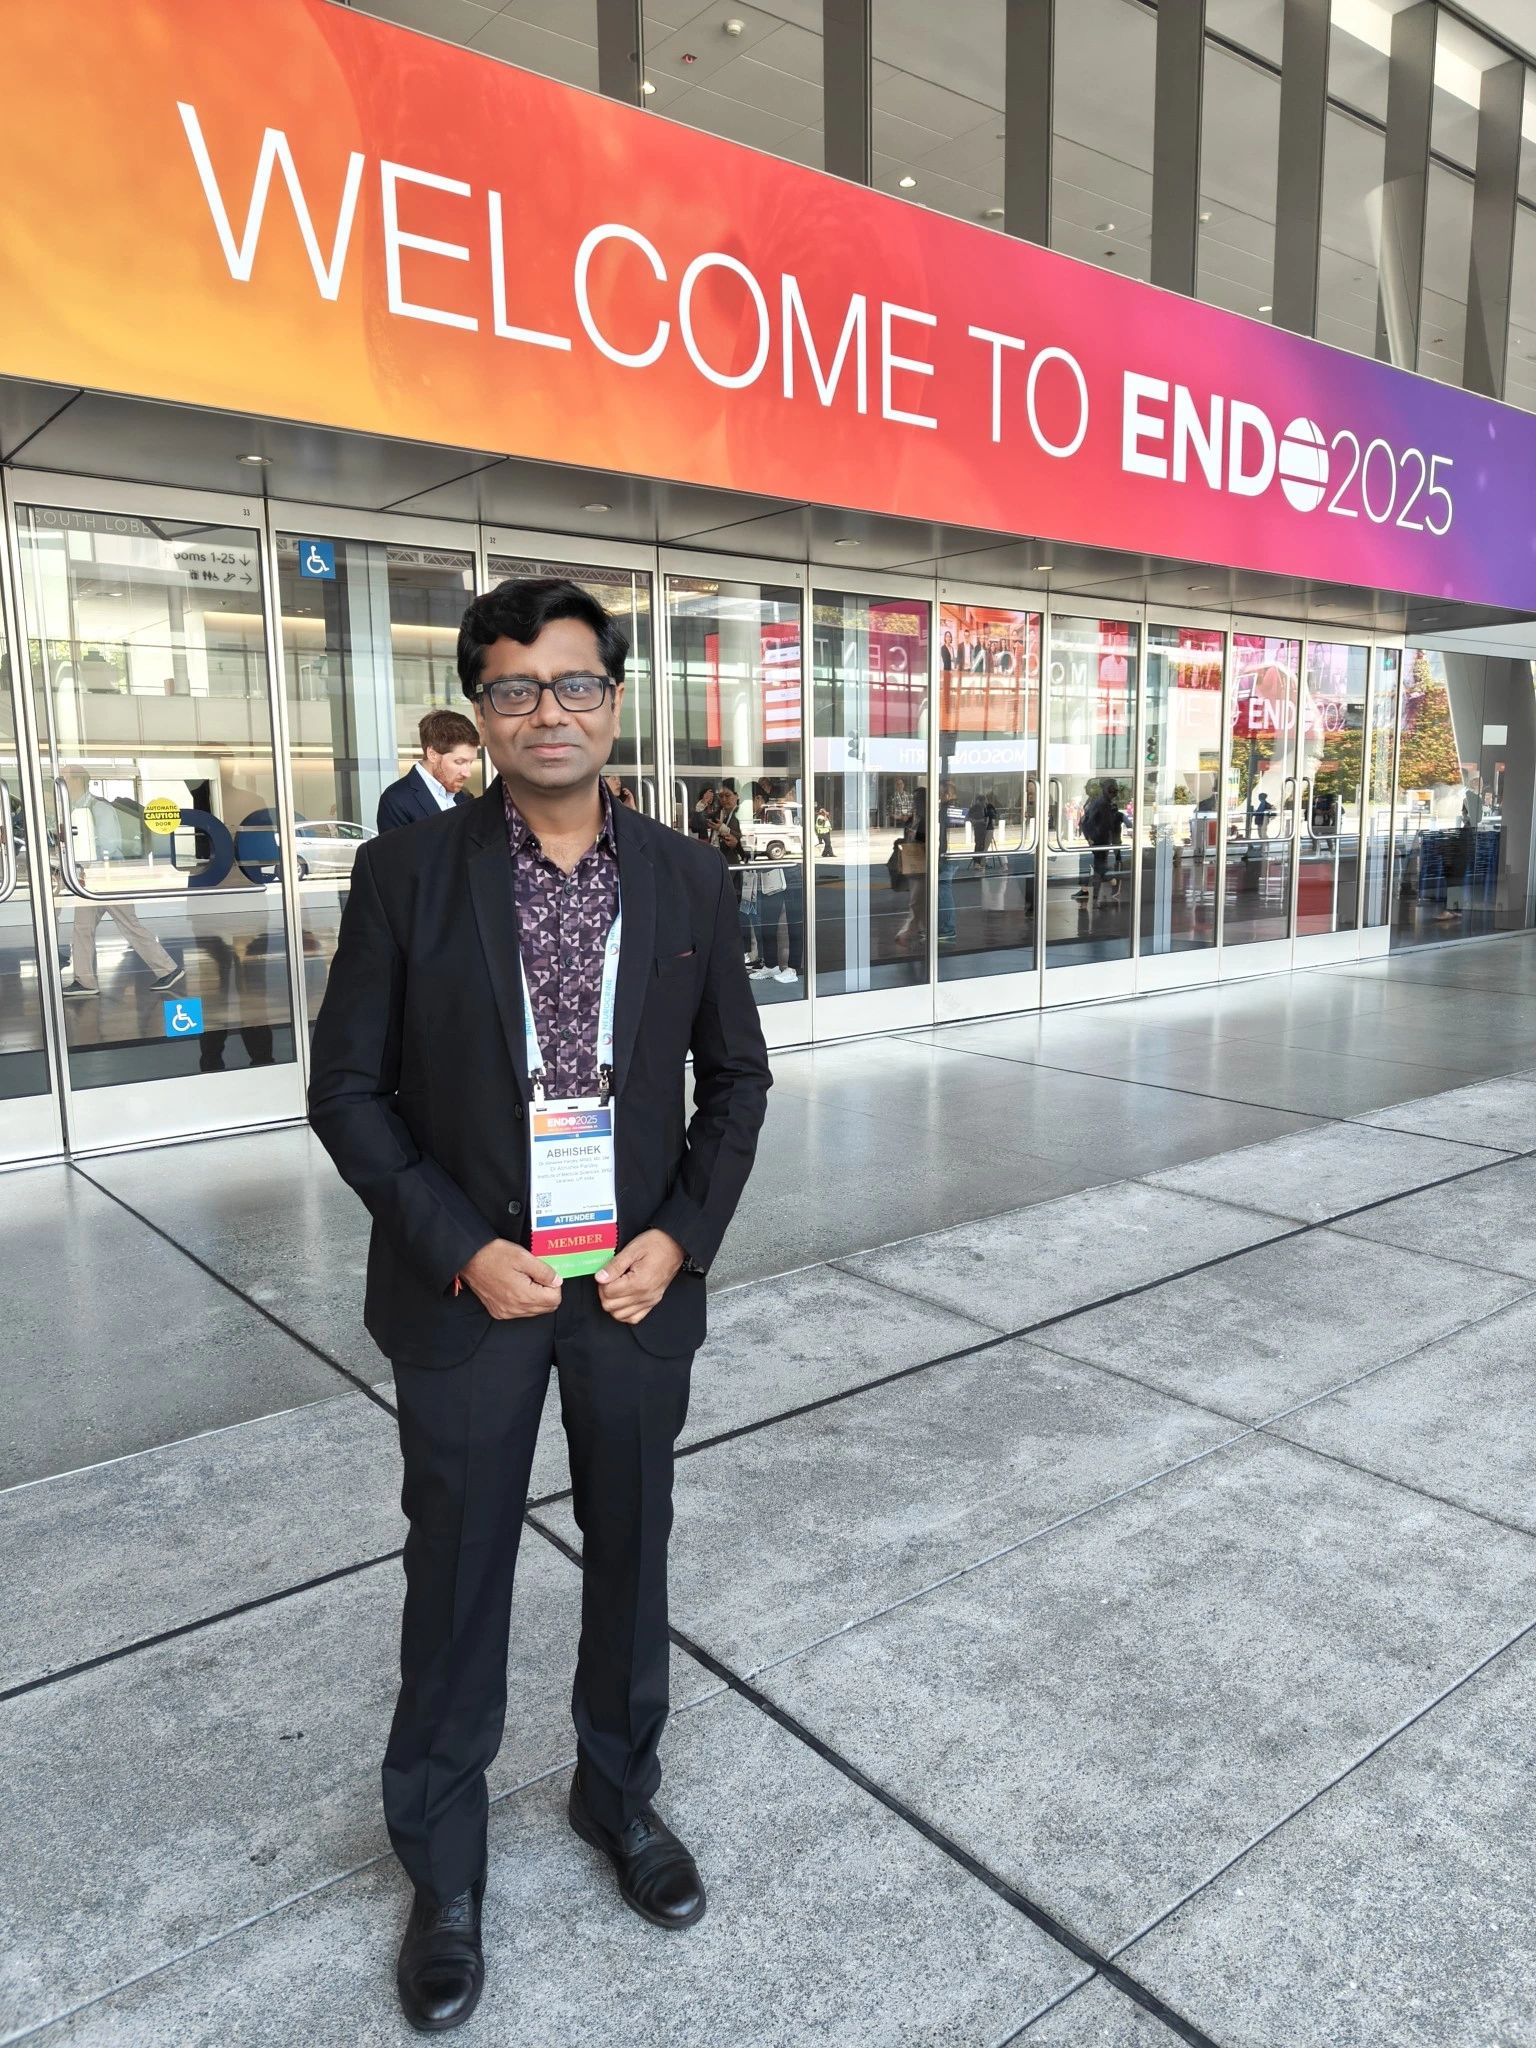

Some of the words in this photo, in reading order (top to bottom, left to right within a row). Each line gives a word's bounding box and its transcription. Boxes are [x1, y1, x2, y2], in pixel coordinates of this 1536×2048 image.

[176, 100, 938, 430] WELCOME
[968, 325, 1089, 458] TO
[242, 508, 251, 517] 33
[211, 551, 236, 564] 1-25
[546, 1145, 601, 1159] ABHISHEK
[554, 1213, 596, 1224] ATTENDEE
[547, 1233, 603, 1249] MEMBER
